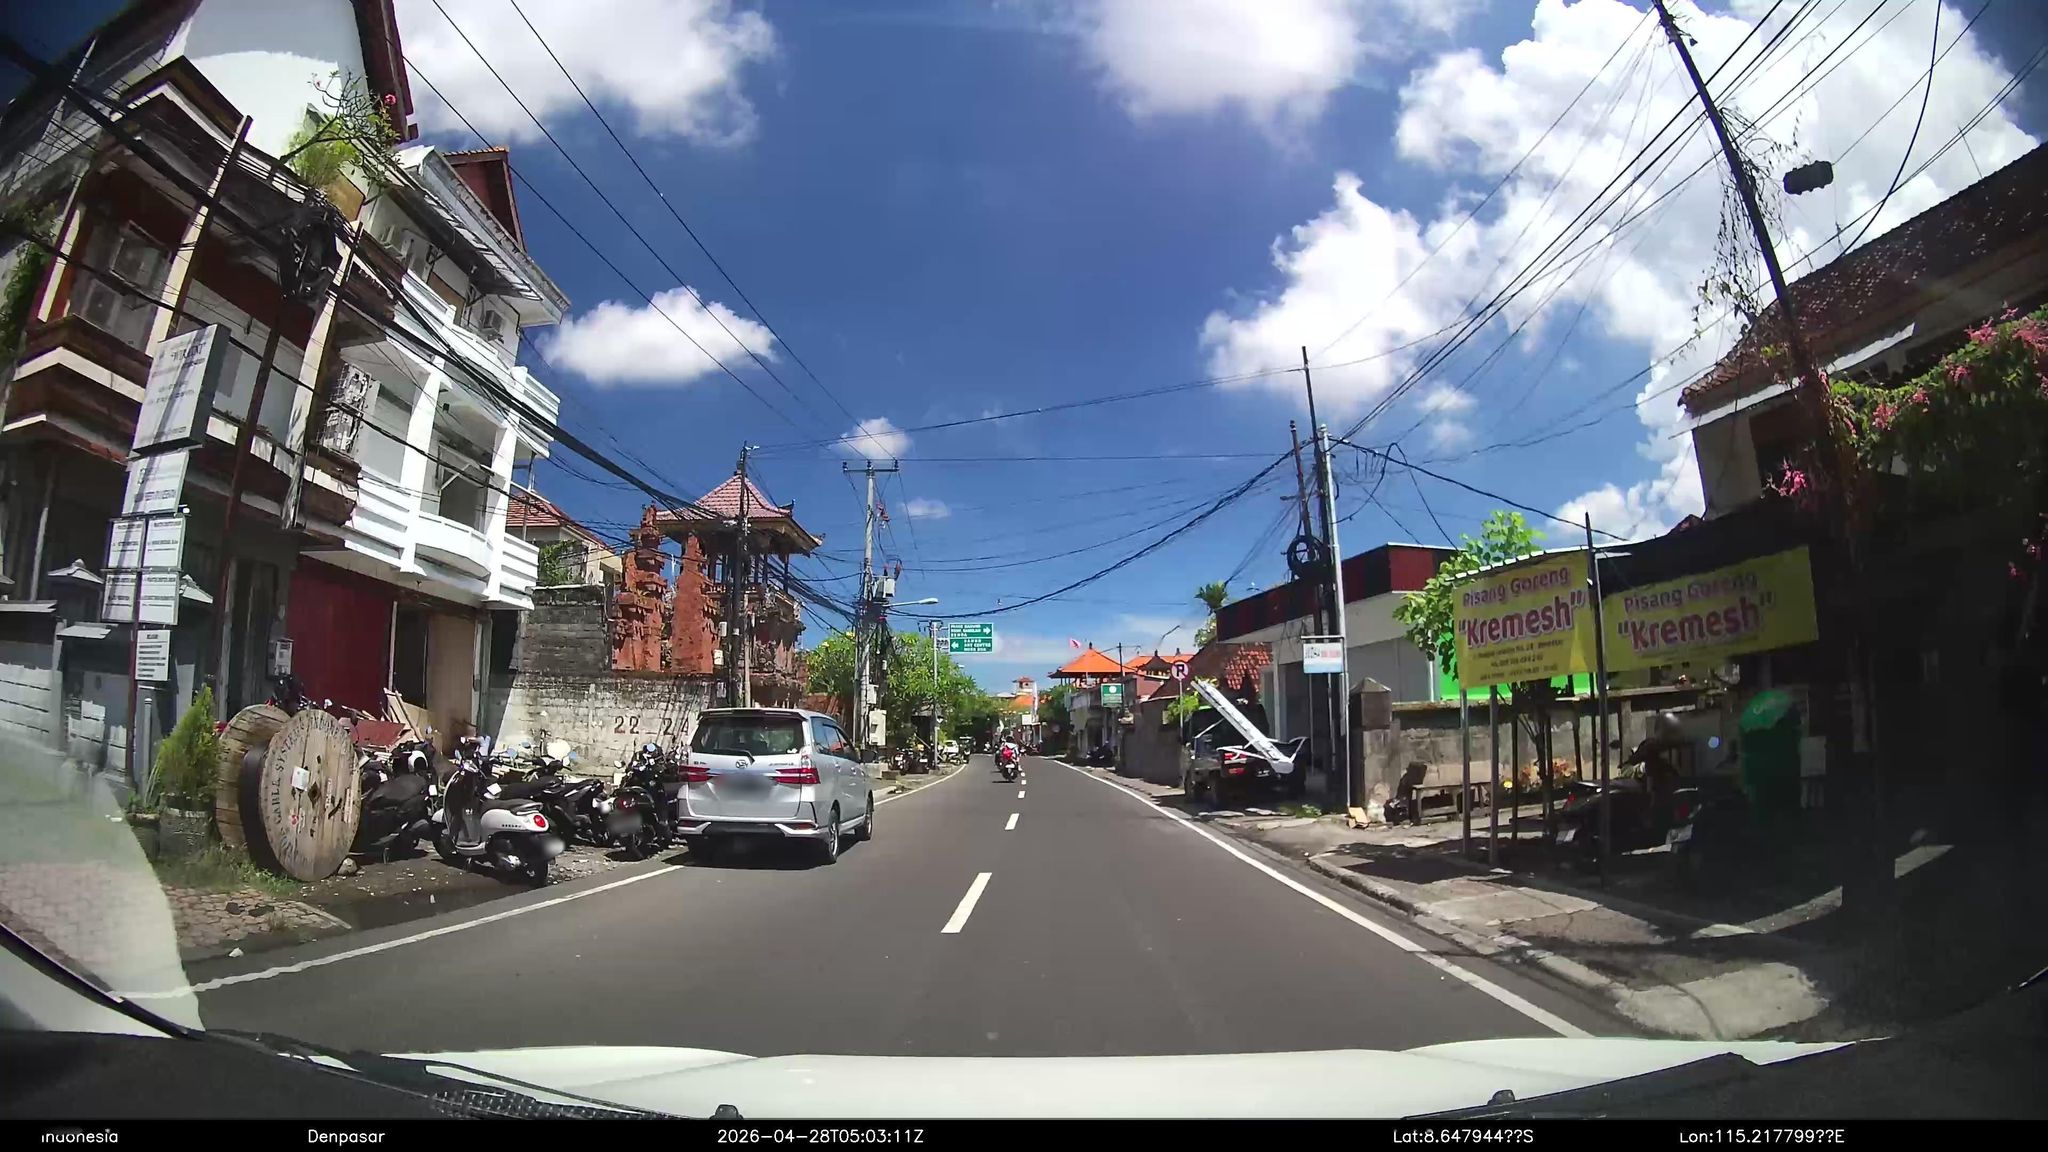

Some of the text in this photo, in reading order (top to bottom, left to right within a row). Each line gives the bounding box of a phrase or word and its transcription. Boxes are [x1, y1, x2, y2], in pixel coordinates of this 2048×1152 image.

[1462, 565, 1570, 608] Pisang Goreng
[1623, 571, 1758, 614] Pisang Goreng
[614, 715, 640, 735] 22
